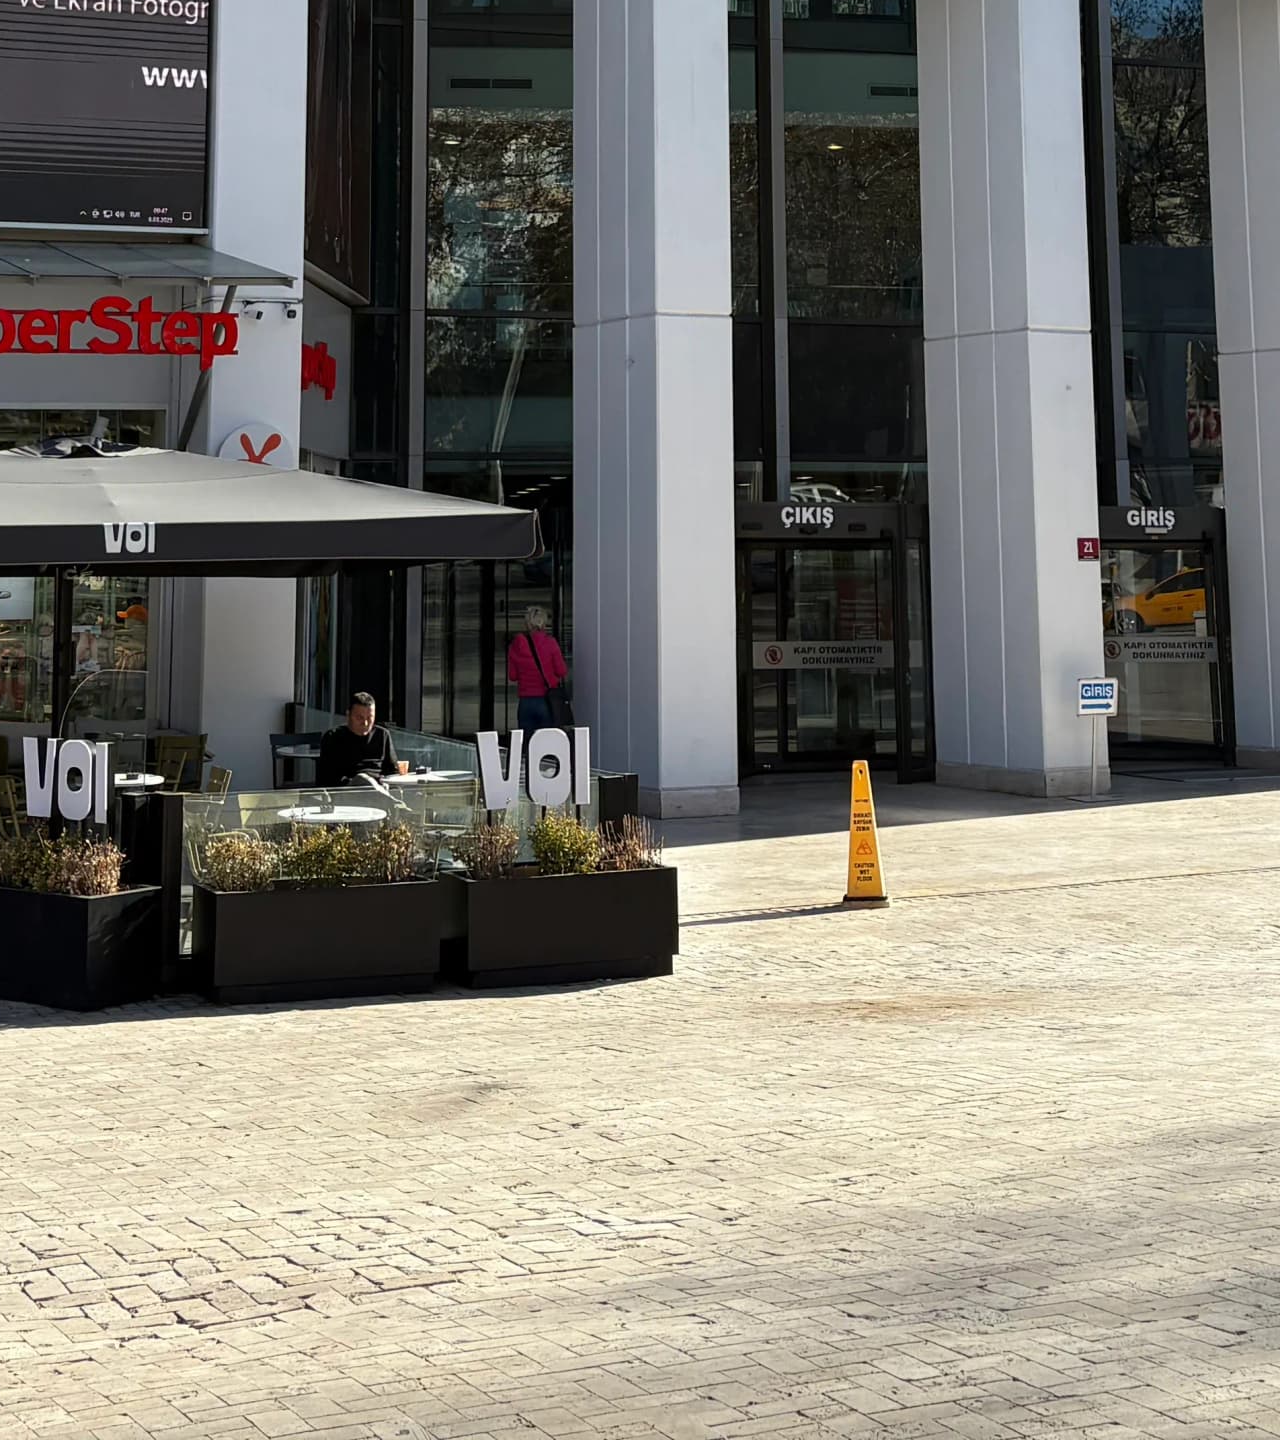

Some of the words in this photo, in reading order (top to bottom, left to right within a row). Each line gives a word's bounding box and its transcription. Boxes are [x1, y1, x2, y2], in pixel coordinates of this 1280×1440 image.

[781, 506, 834, 528] ÇIKIŞ
[1127, 507, 1175, 529] GİRİŞ
[104, 522, 156, 554] VOI
[1084, 542, 1093, 553] 21
[794, 646, 816, 654] KAPI
[1082, 683, 1113, 699] GİRİŞ
[477, 727, 590, 810] VOI
[23, 737, 112, 824] VOI
